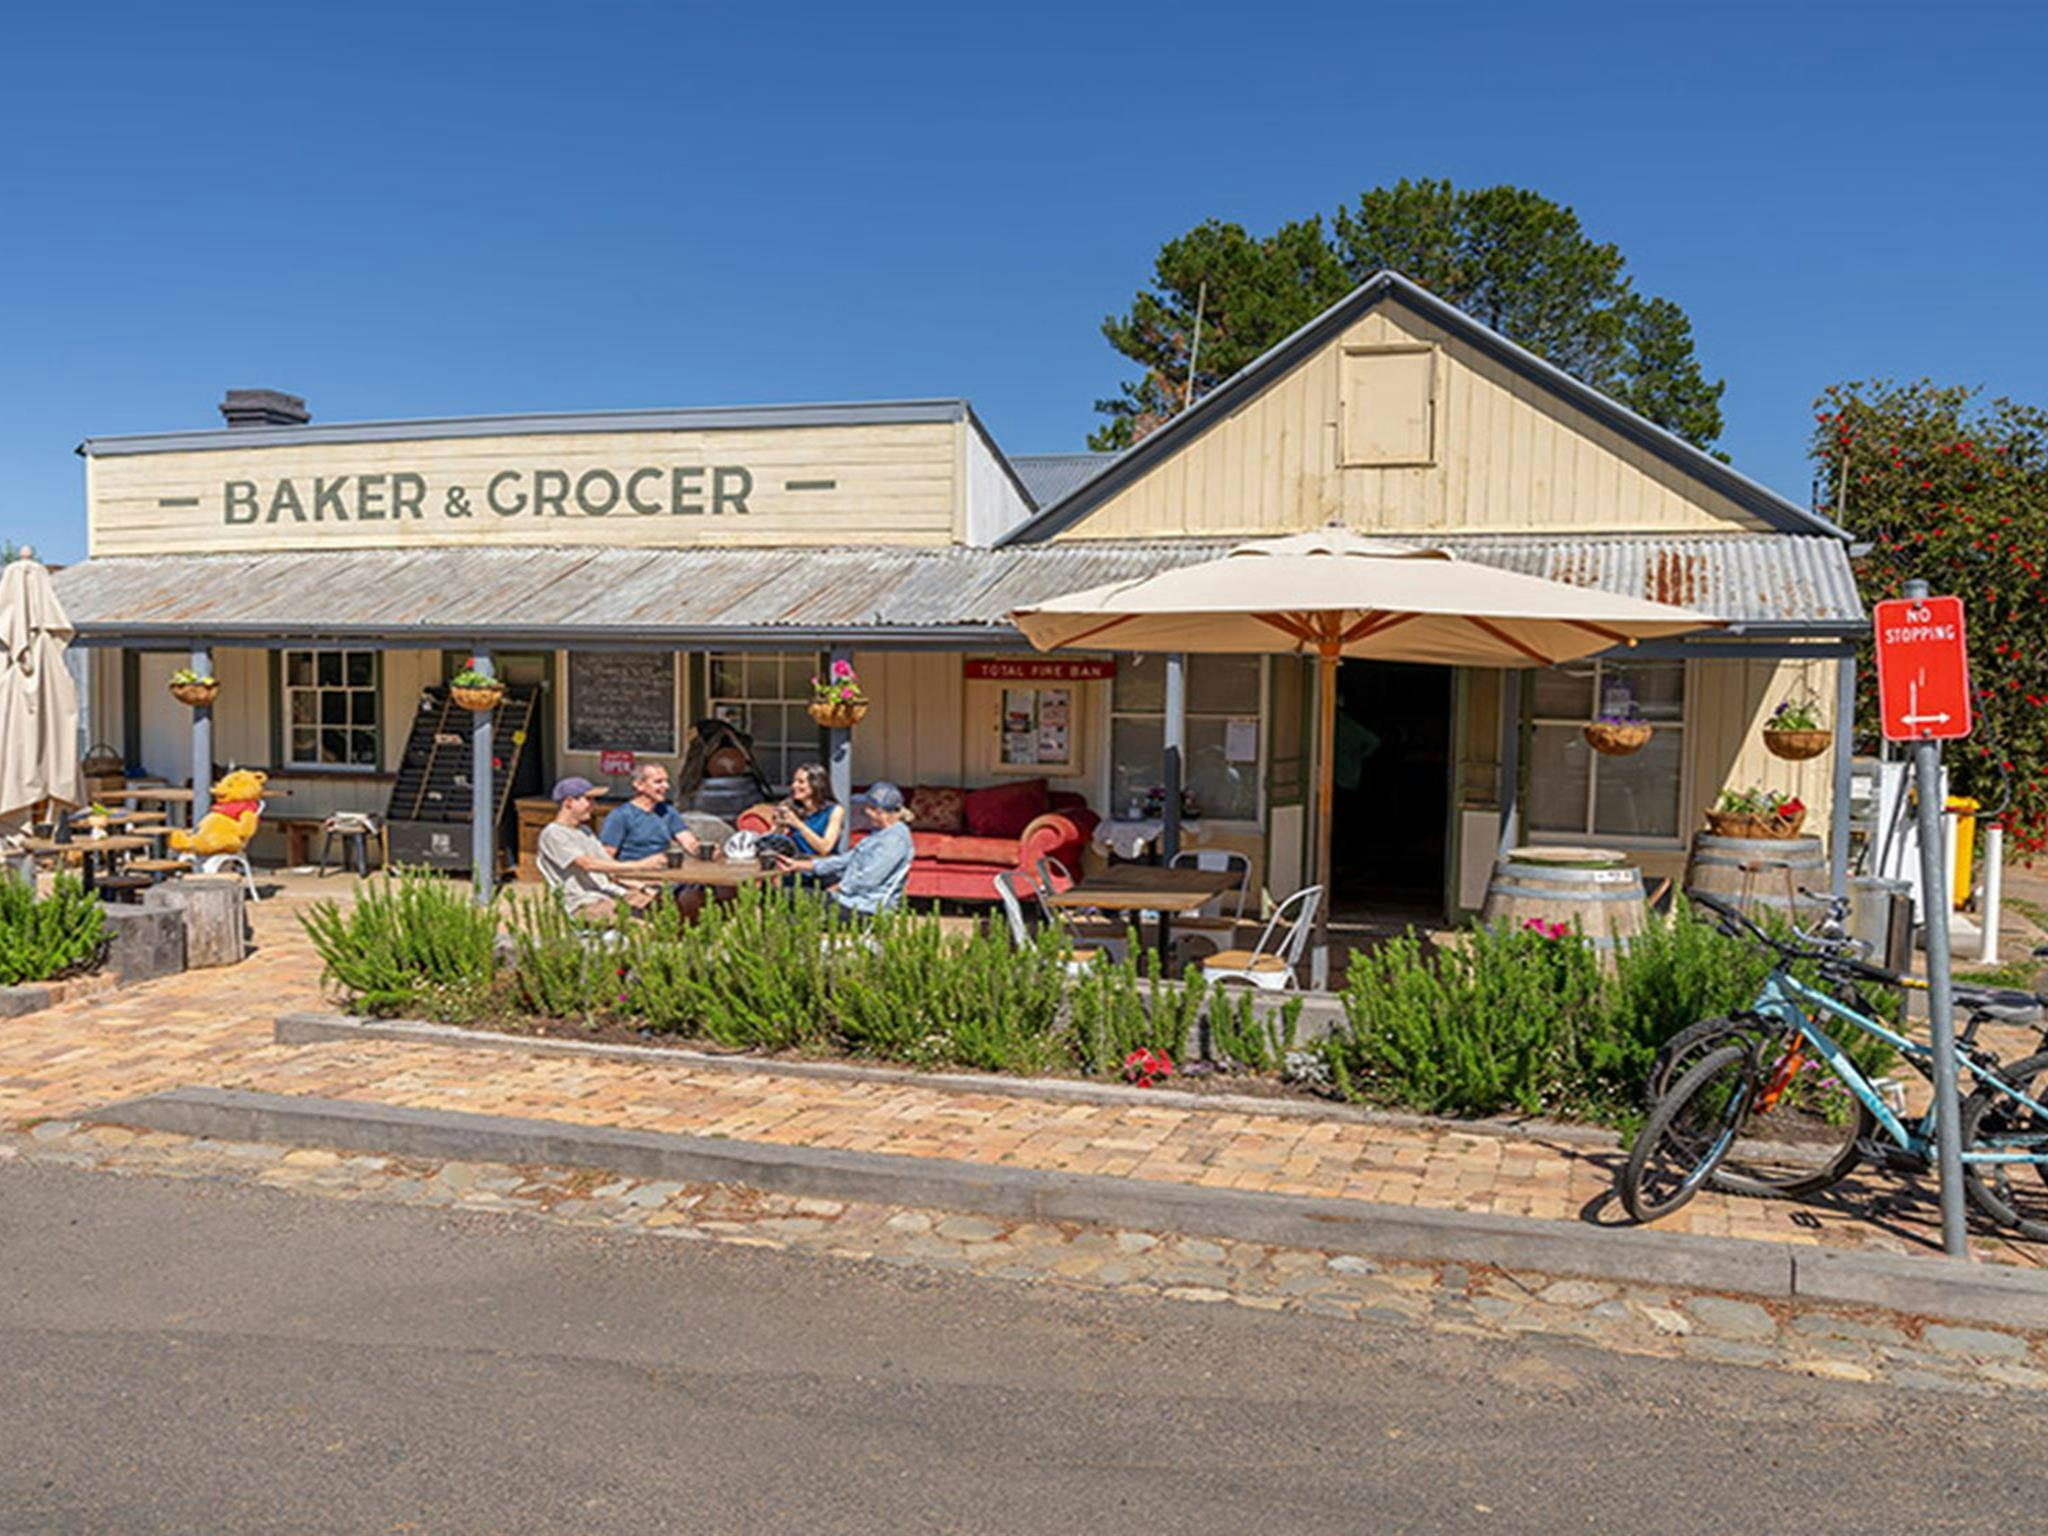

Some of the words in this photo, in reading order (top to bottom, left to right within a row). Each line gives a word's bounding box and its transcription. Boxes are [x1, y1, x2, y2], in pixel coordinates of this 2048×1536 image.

[224, 472, 427, 524] BAKER
[444, 485, 473, 518] &
[487, 466, 753, 516] GROCER
[1906, 607, 1932, 623] NO
[1885, 625, 1955, 644] STOPPING
[981, 664, 1024, 676] TOTAL
[1032, 665, 1063, 676] FIRE
[1070, 664, 1101, 676] BAN
